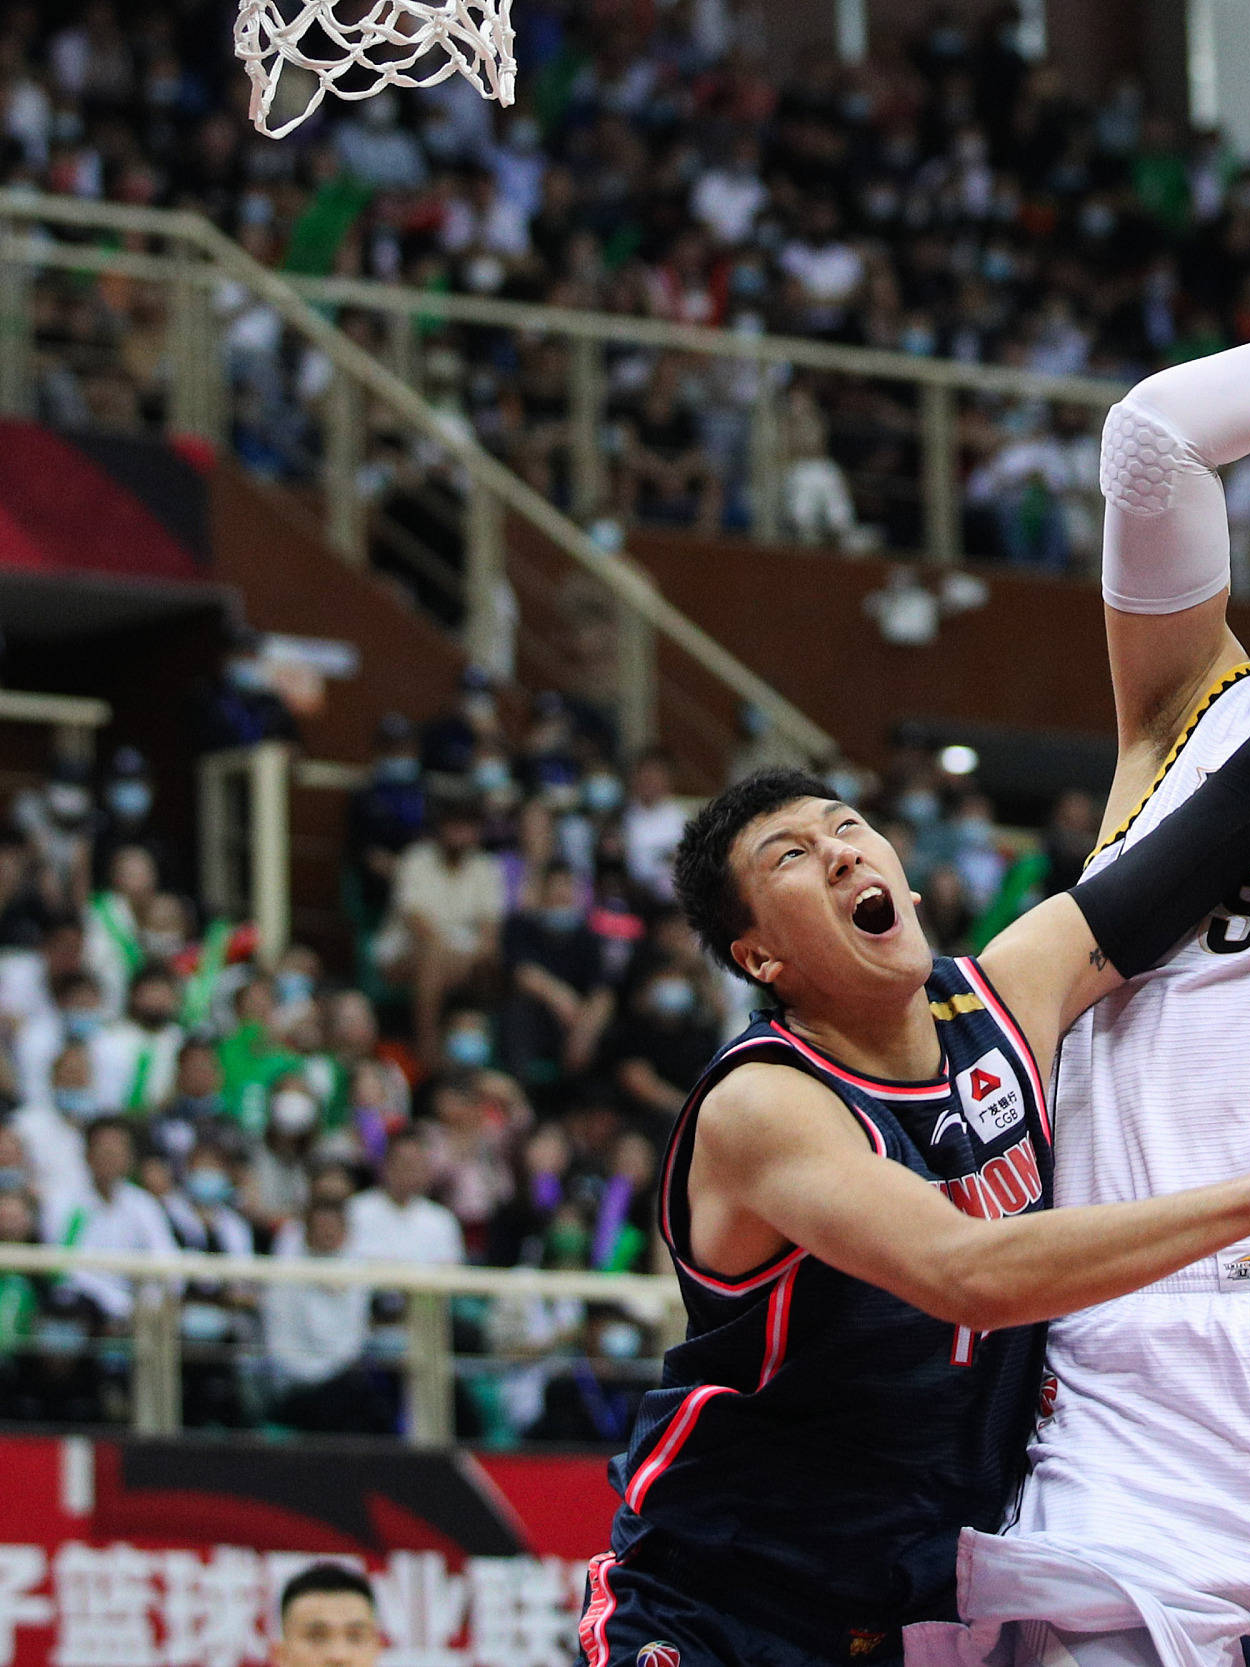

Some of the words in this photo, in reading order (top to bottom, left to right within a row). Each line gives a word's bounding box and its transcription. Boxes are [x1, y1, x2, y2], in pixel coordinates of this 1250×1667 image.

[979, 1090, 1018, 1124] 广发银行
[995, 1108, 1019, 1129] CGB
